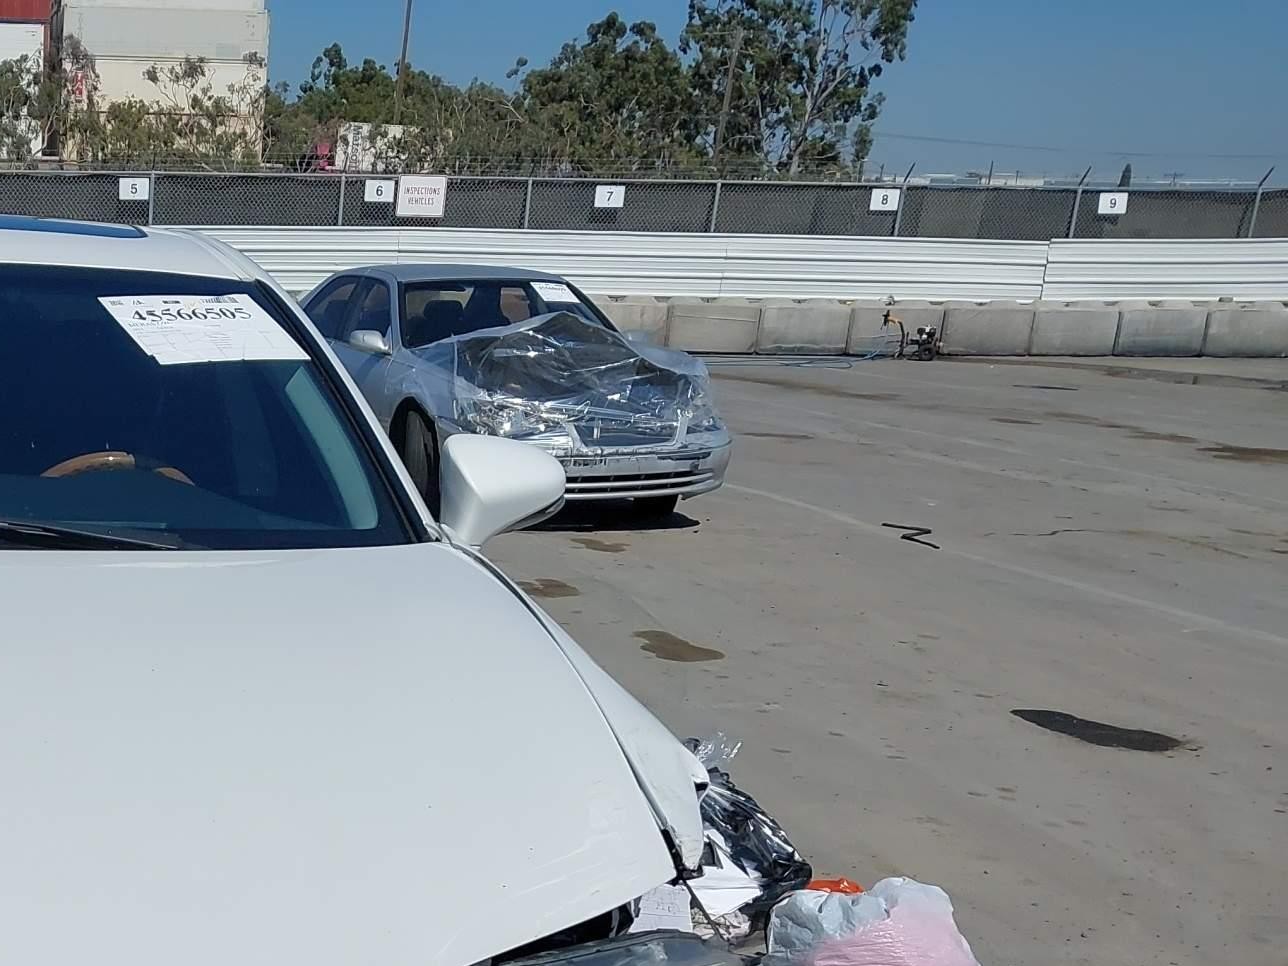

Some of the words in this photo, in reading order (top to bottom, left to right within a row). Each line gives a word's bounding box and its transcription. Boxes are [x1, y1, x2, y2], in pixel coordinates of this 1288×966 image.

[130, 183, 138, 195] 5
[375, 185, 384, 197] 6
[403, 186, 441, 195] INSPECTIONS
[407, 197, 435, 206] VEHICLES
[606, 191, 614, 201] 7
[881, 194, 889, 205] 8
[1109, 197, 1117, 209] 9
[132, 308, 252, 322] 45566505
